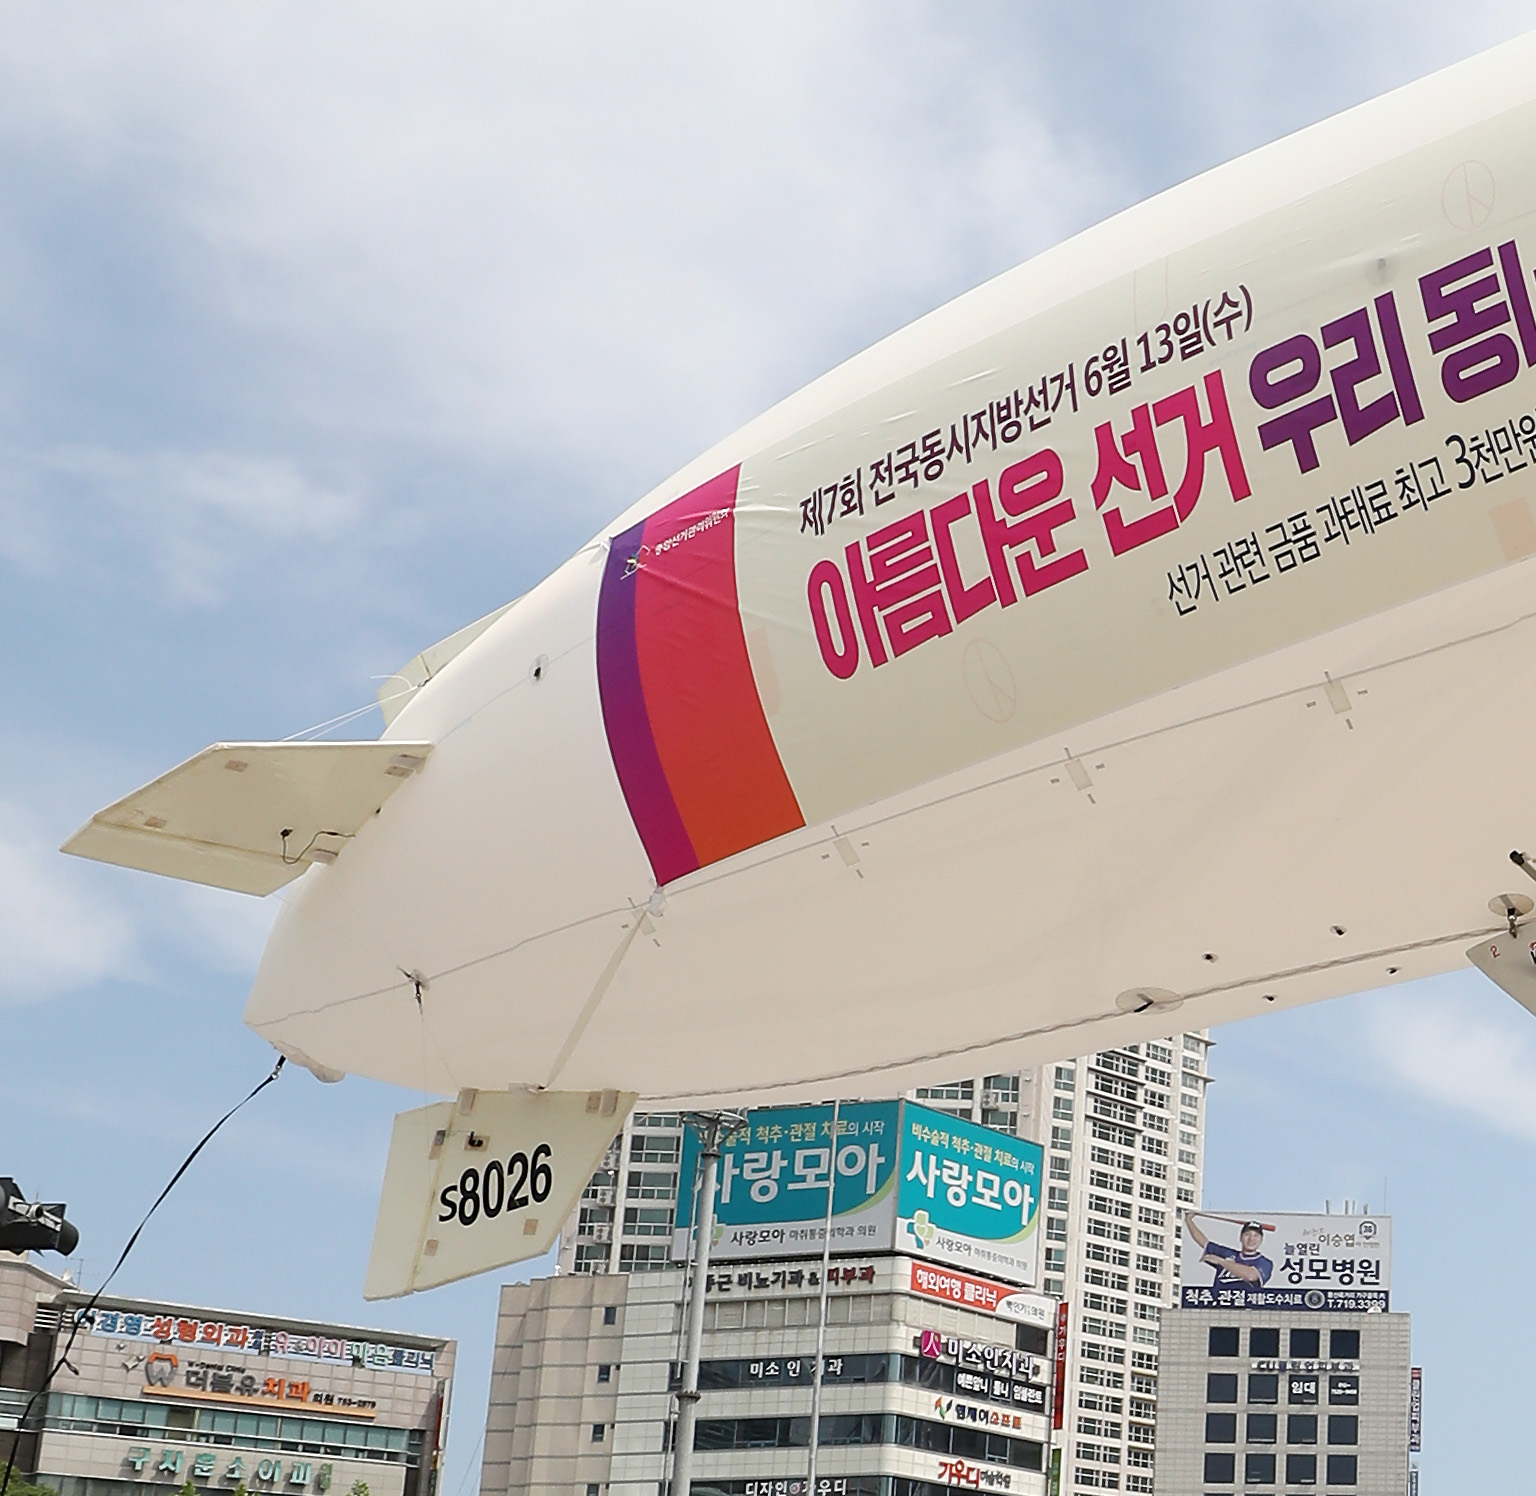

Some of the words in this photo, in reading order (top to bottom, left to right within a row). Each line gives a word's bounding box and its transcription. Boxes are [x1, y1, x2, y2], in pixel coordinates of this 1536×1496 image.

[799, 468, 864, 535] 제7회
[869, 364, 1078, 506] 전국동시지방선거
[1084, 338, 1132, 397] 6월
[1136, 284, 1254, 373] 13일(수)
[806, 448, 1089, 680] 아름다운
[1090, 369, 1253, 557] 선거
[1248, 290, 1425, 475] 우리
[1166, 554, 1219, 617] 선거
[1213, 531, 1271, 593] 관련
[1265, 511, 1321, 573] 금품
[1315, 479, 1398, 546] 과태료
[1393, 456, 1453, 512] 최고
[863, 1120, 885, 1136] 시작
[906, 1150, 1035, 1226] 사랑모아
[730, 1229, 785, 1247] 사랑모아
[935, 1236, 972, 1257] 사랑모아
[1319, 1234, 1355, 1248] 이승엽
[737, 1269, 805, 1290] 비뇨기과
[828, 1265, 876, 1286] 피부과
[1280, 1258, 1380, 1285] 성모병원
[916, 1268, 962, 1298] 해외여행
[963, 1281, 998, 1307] 클리닉
[152, 1316, 248, 1348] 성형외과
[948, 1338, 1034, 1378] 미소인치과
[1291, 1382, 1315, 1394] 임대
